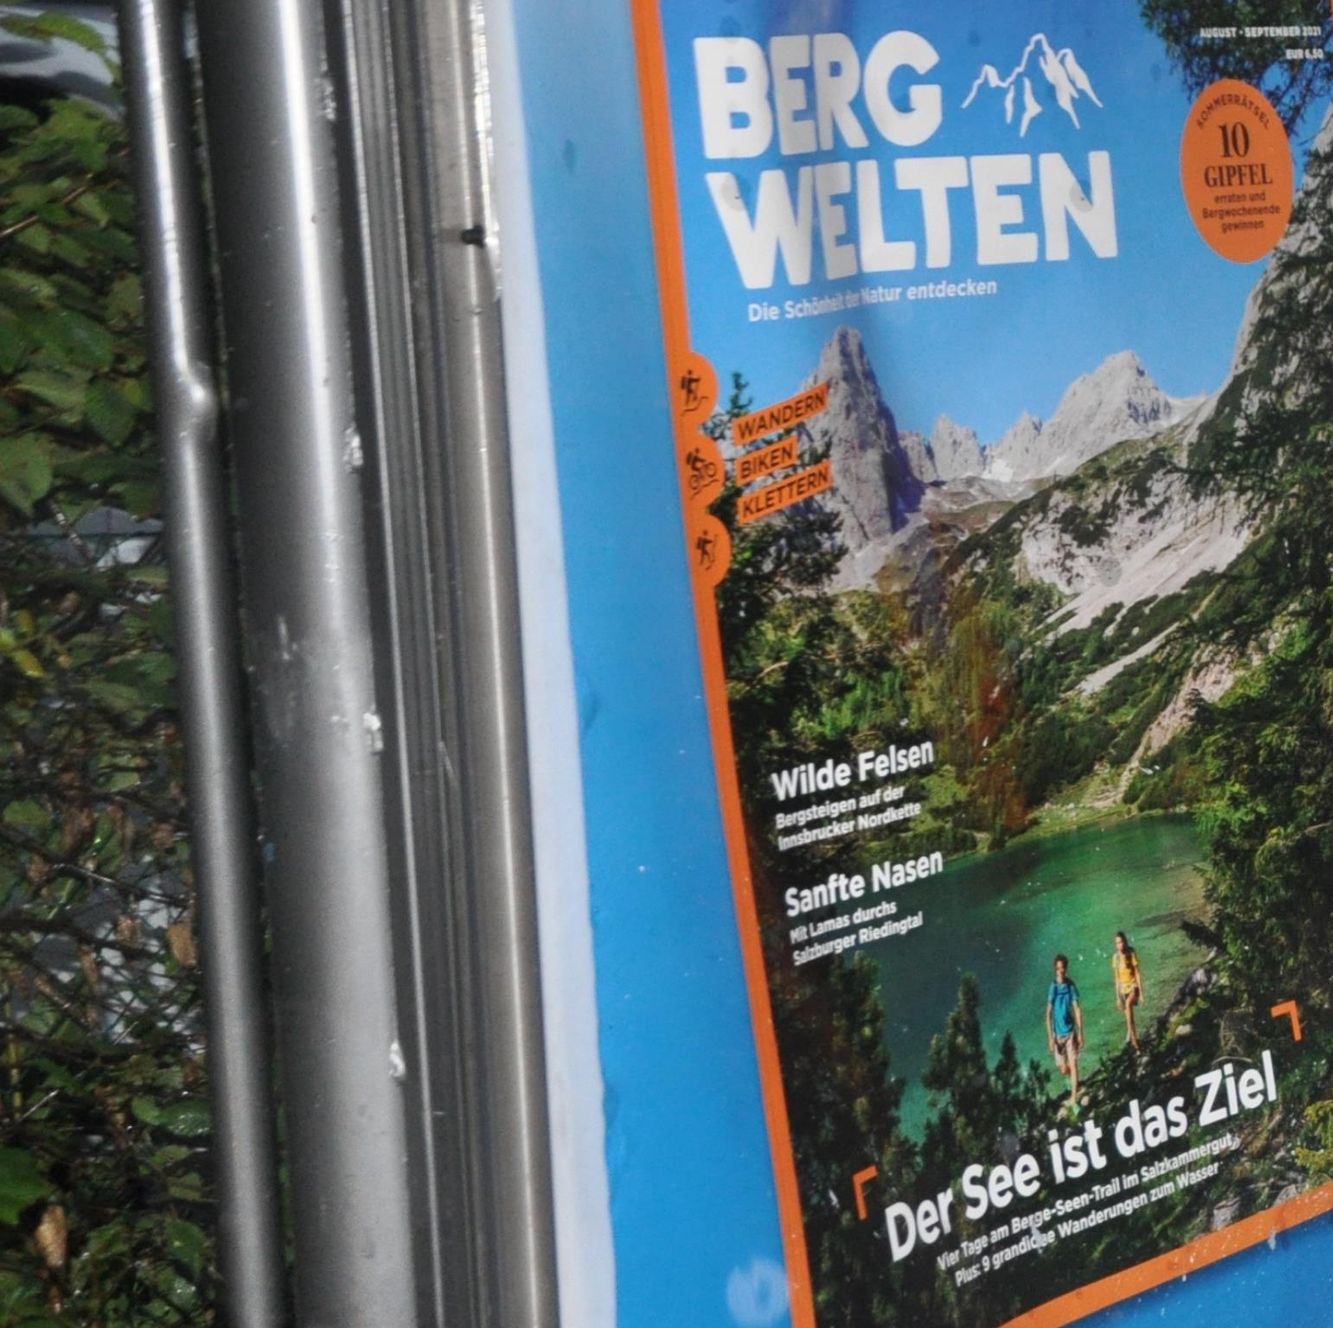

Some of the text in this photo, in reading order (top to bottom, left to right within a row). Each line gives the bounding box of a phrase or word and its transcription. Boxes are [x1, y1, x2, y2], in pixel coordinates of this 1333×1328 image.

[1200, 26, 1322, 38] AUGUST SEPTEMBER 2021
[1285, 49, 1304, 59] EUR
[693, 30, 943, 158] BERG
[1196, 93, 1270, 130] SOMMERRÄTSEL
[1218, 121, 1250, 159] 10
[1204, 163, 1273, 188] GIPFEL
[1214, 191, 1266, 204] erraten und
[705, 150, 1118, 289] WELTEN
[1202, 204, 1281, 219] Bergwochenende
[1221, 219, 1264, 234] gewinnen
[748, 303, 779, 322] Die
[861, 286, 901, 304] Natur
[907, 279, 998, 300] entdecken
[738, 390, 826, 439] WANDERN
[740, 443, 793, 479] BIKEN
[743, 470, 829, 518] KLETTERN
[771, 741, 934, 801] Wilde Felsen
[775, 785, 906, 829] Bergsteigen auf der
[778, 802, 922, 851] Innsbrucker Nordkette
[785, 851, 943, 917] Sanfte Nasen
[789, 901, 897, 945] Mit Lamas durchs
[792, 910, 924, 967] Salzburger Riedingtal
[885, 1050, 1278, 1262] Der See ist das Ziel
[937, 1249, 960, 1271] Vier
[960, 1234, 989, 1257] Tage
[990, 1224, 1009, 1243] am
[1011, 1177, 1121, 1234] Berge-Seen-Trail
[1122, 1172, 1139, 1190] im
[955, 1262, 981, 1287] Plus:
[981, 1255, 991, 1272] 9
[1057, 1192, 1148, 1238] Wanderungen
[1150, 1181, 1175, 1202] zum
[1176, 1162, 1219, 1189] Wasser
